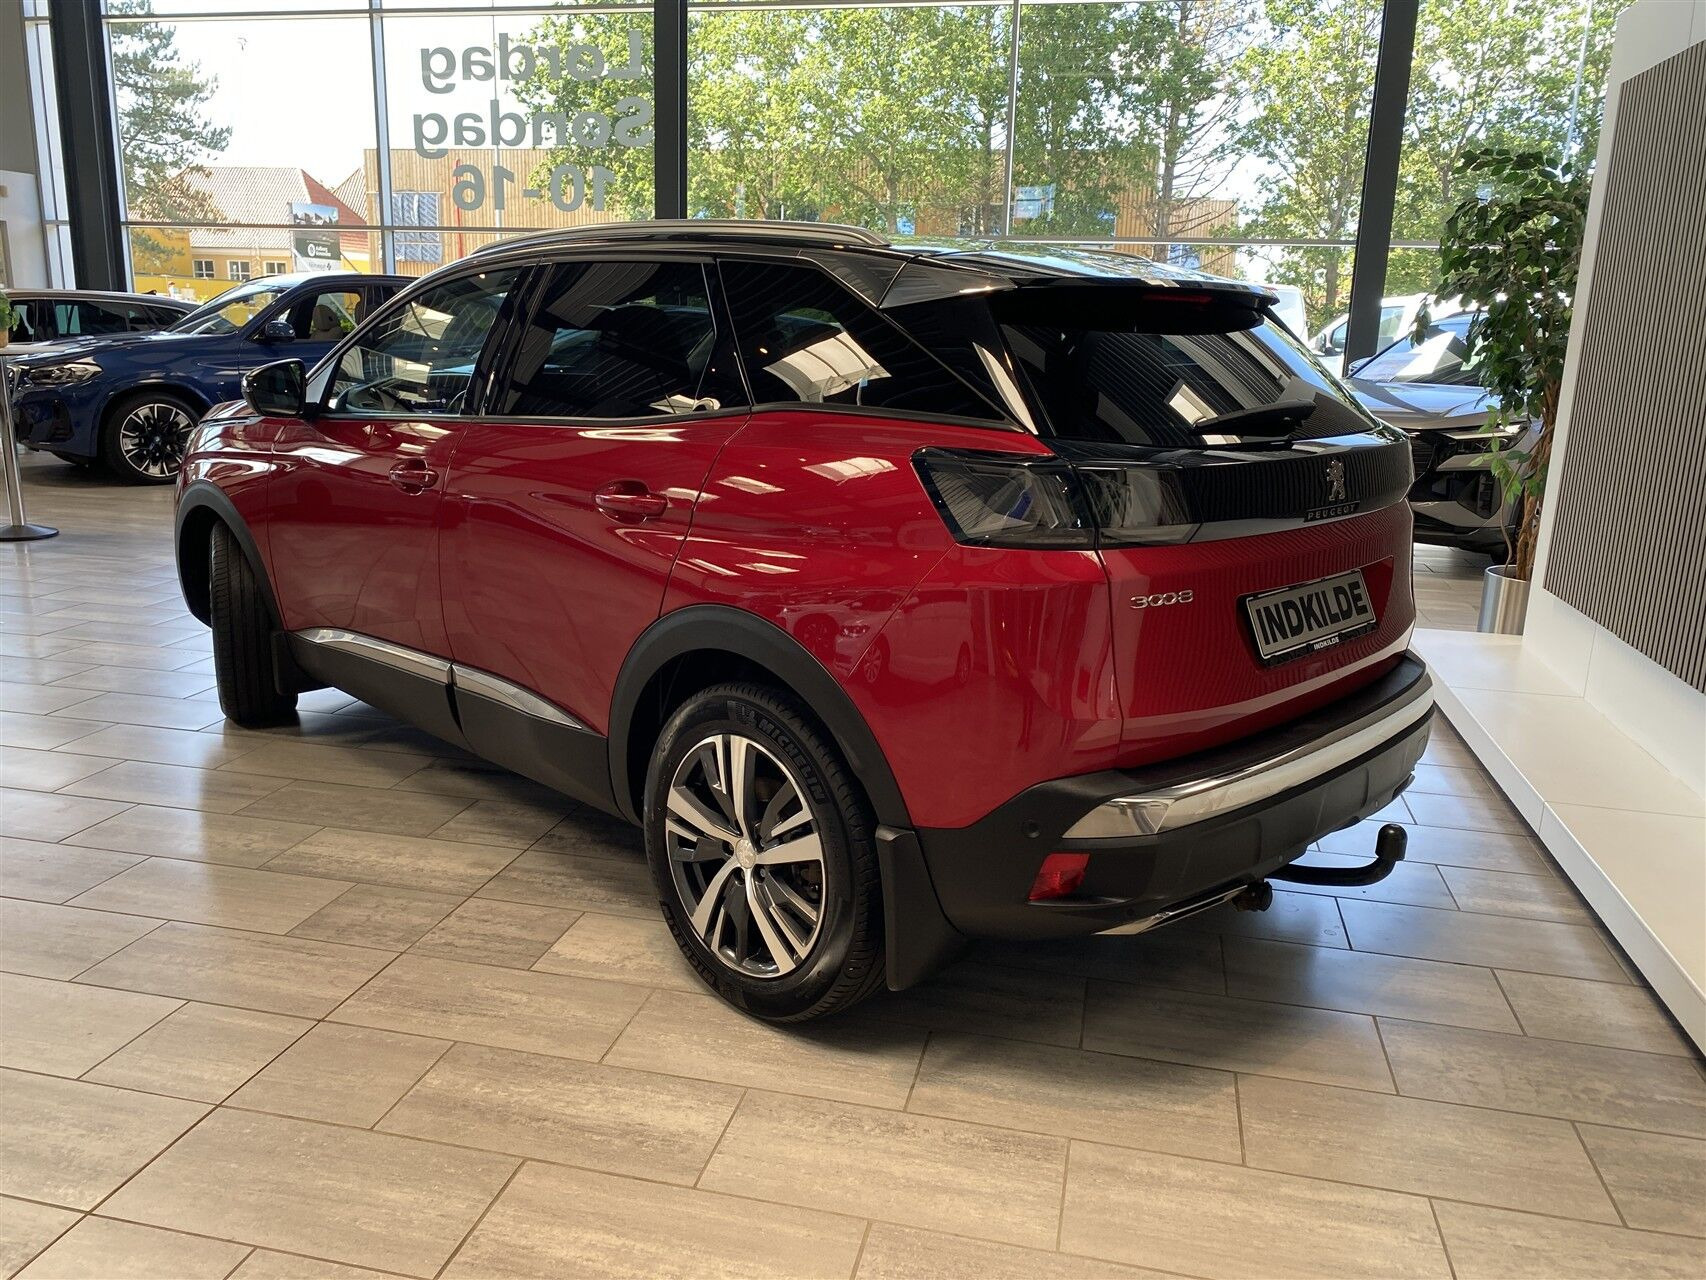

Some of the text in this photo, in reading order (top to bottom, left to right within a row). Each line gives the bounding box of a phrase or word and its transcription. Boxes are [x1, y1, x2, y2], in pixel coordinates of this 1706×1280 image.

[1307, 504, 1355, 520] PEUGEOT
[1130, 590, 1194, 608] 3008
[1255, 581, 1368, 645] INDKILDE
[1313, 635, 1340, 650] INDKILDE
[758, 717, 826, 803] MICHELIN
